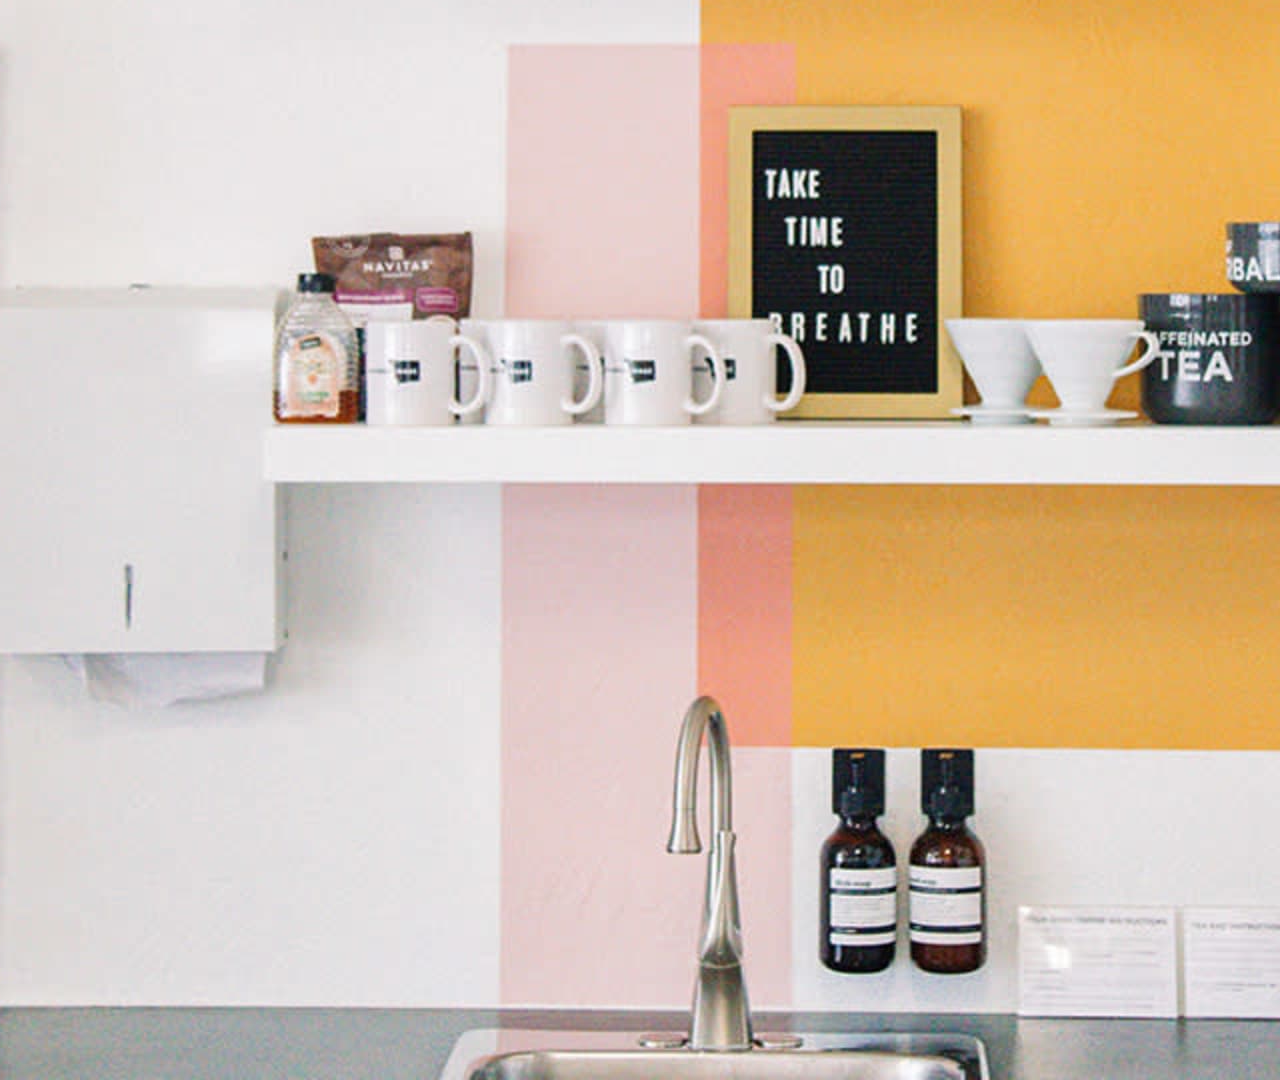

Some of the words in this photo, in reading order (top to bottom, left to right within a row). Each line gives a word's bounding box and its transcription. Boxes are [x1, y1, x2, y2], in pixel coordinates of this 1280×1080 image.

[765, 169, 820, 199] TAKE
[784, 216, 843, 247] TIME
[363, 260, 430, 273] NAVITAS
[818, 264, 845, 294] TO
[768, 312, 918, 343] BREATHE
[1157, 349, 1234, 382] TEA
